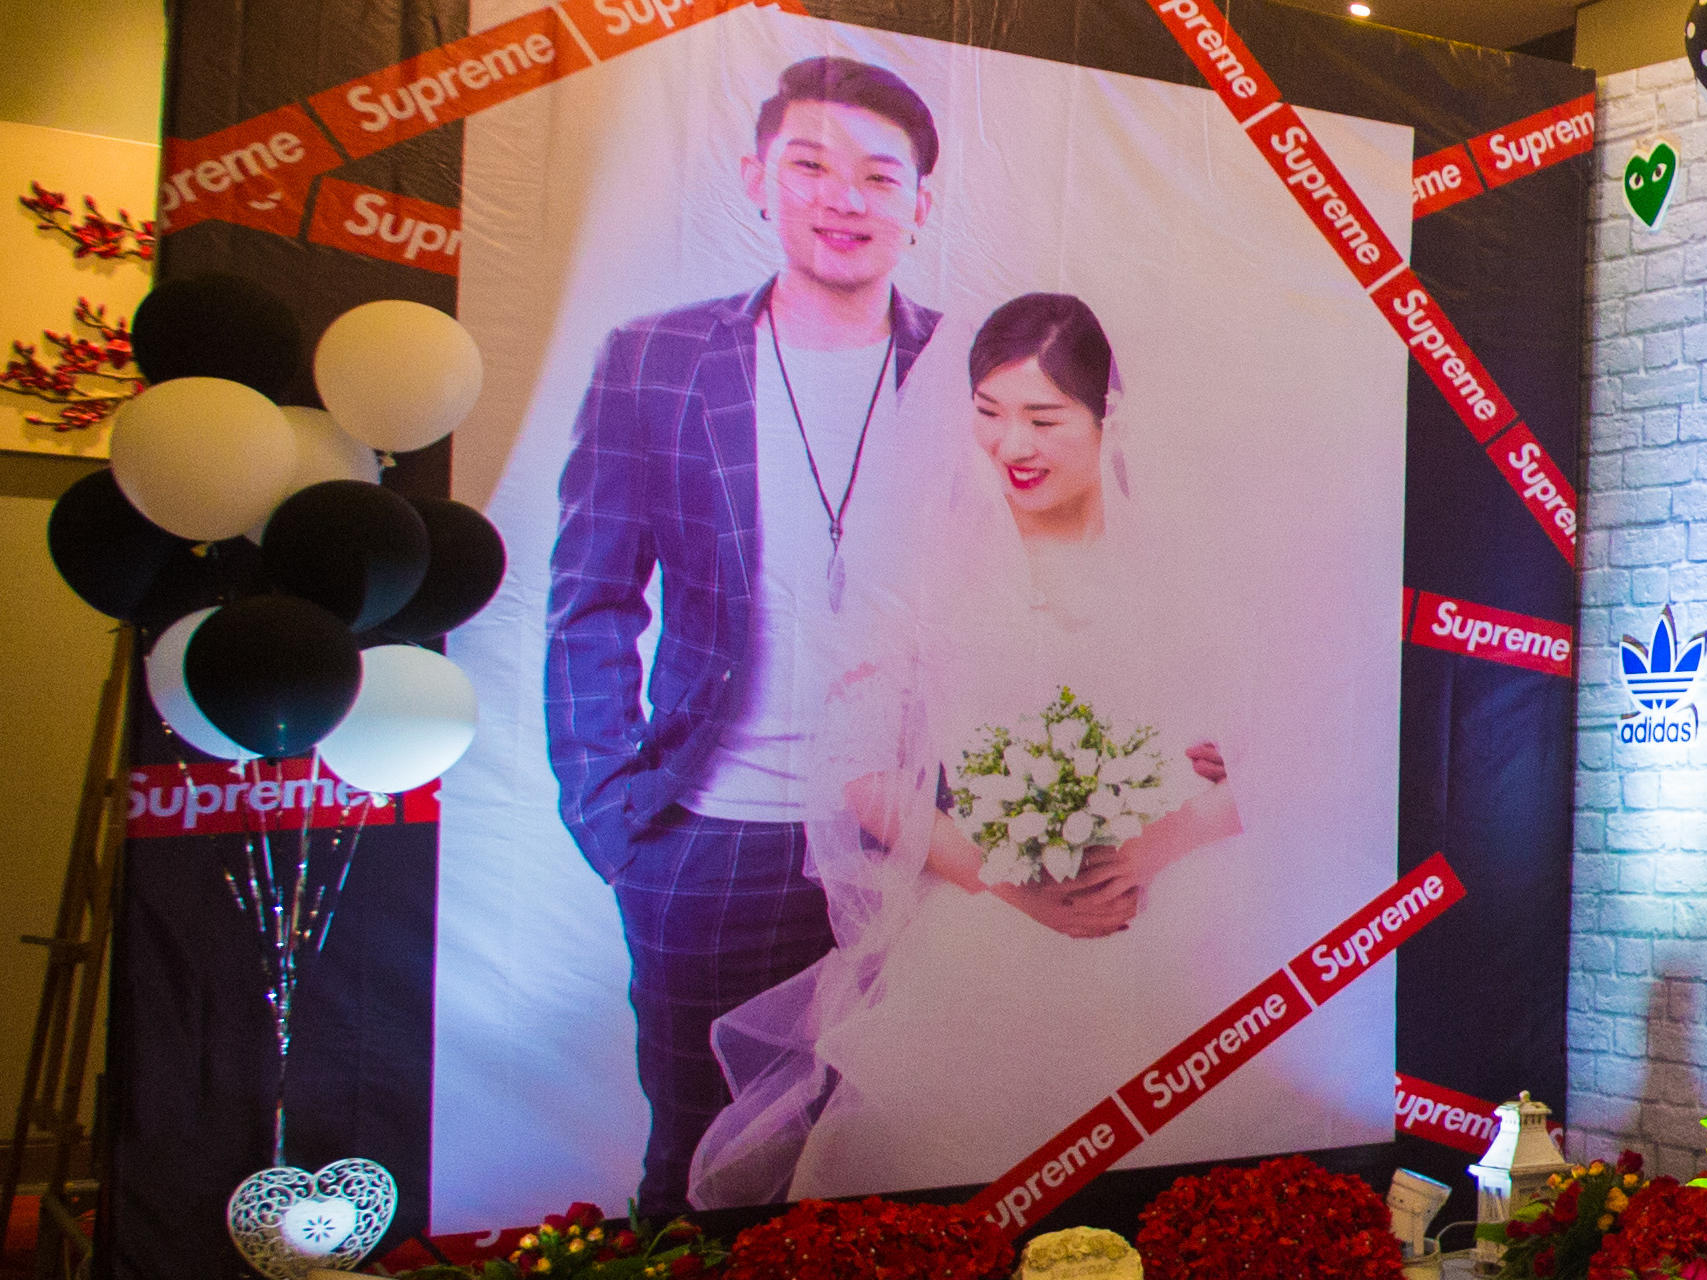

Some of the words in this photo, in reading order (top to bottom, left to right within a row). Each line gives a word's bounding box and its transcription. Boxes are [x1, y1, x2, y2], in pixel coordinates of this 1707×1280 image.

[346, 33, 555, 132] Supreme
[1271, 126, 1381, 265] Supreme
[1393, 289, 1497, 421] Supreme
[1431, 601, 1571, 662] Supreme
[1621, 715, 1692, 744] adidas
[1311, 875, 1445, 982] Supreme
[984, 1123, 1115, 1230] upreme
[1142, 993, 1288, 1110] Supreme
[1396, 1075, 1500, 1138] uprem
